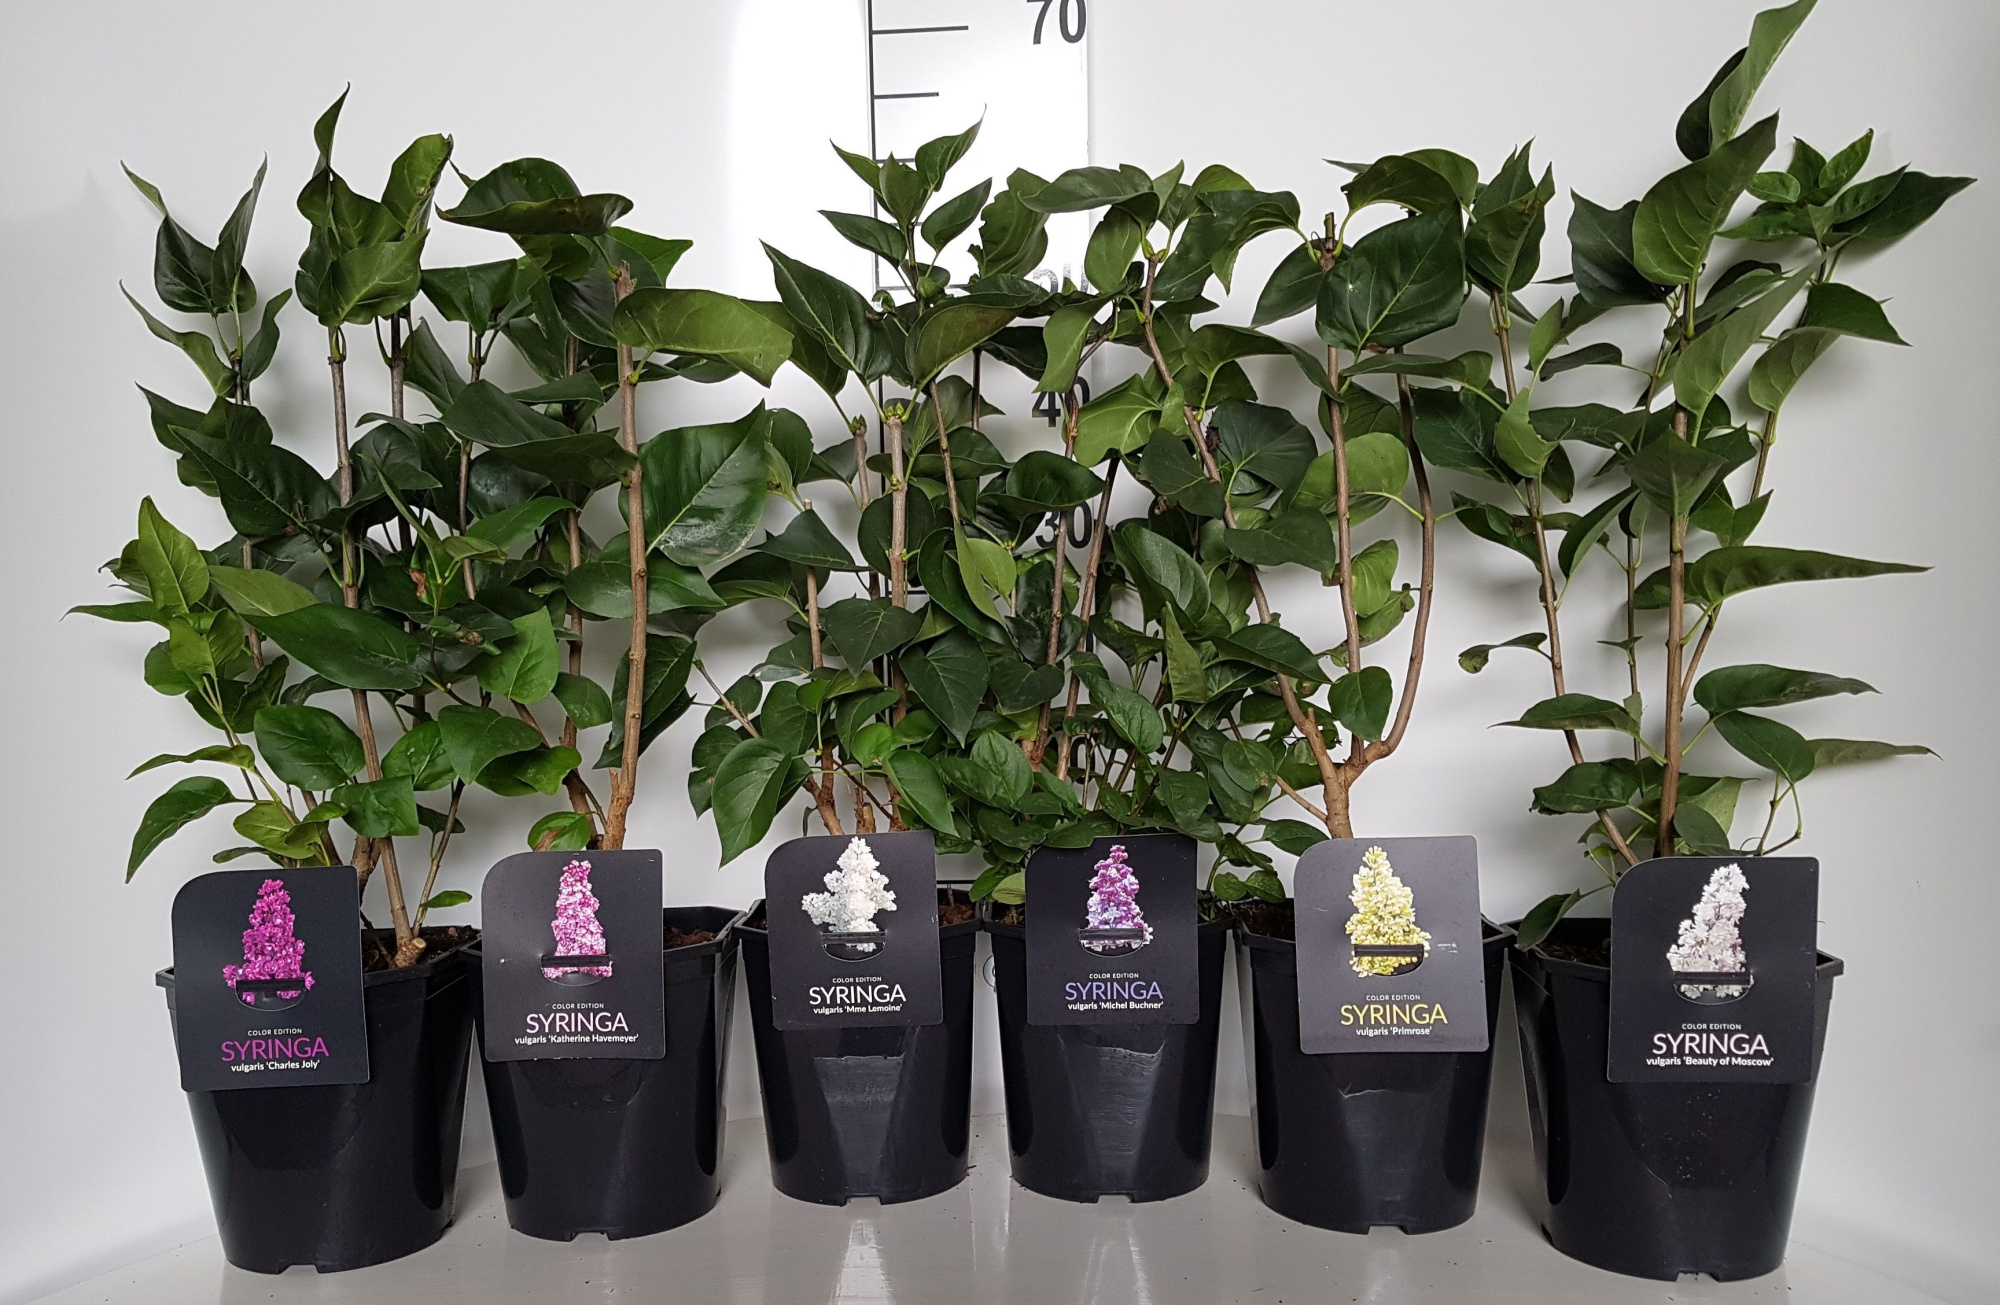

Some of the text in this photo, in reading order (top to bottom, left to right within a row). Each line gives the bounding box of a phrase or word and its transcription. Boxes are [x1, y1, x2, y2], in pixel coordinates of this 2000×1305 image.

[1026, 0, 1087, 45] 70
[809, 983, 907, 1005] SYRINGA
[1065, 981, 1163, 1001] SYRINGA
[813, 1004, 903, 1015] vulgaris 'Mme Lemoine'
[1067, 1001, 1164, 1011] vulgaris 'Michel Buchner'
[1340, 1003, 1448, 1026] SYRINGA
[526, 1012, 629, 1034] SYRINGA
[1355, 1026, 1432, 1037] vulgaris 'Primrose'
[247, 1029, 272, 1037] COLOR
[514, 1033, 639, 1045] vulgaris 'Katherine Havemeyer'
[221, 1036, 330, 1062] SYRINGA
[1652, 1033, 1770, 1056] SYRINGA
[230, 1059, 320, 1073] vulgaris 'Charles Joly'
[1646, 1056, 1774, 1067] vulgaris 'Beauty of Moscow'
